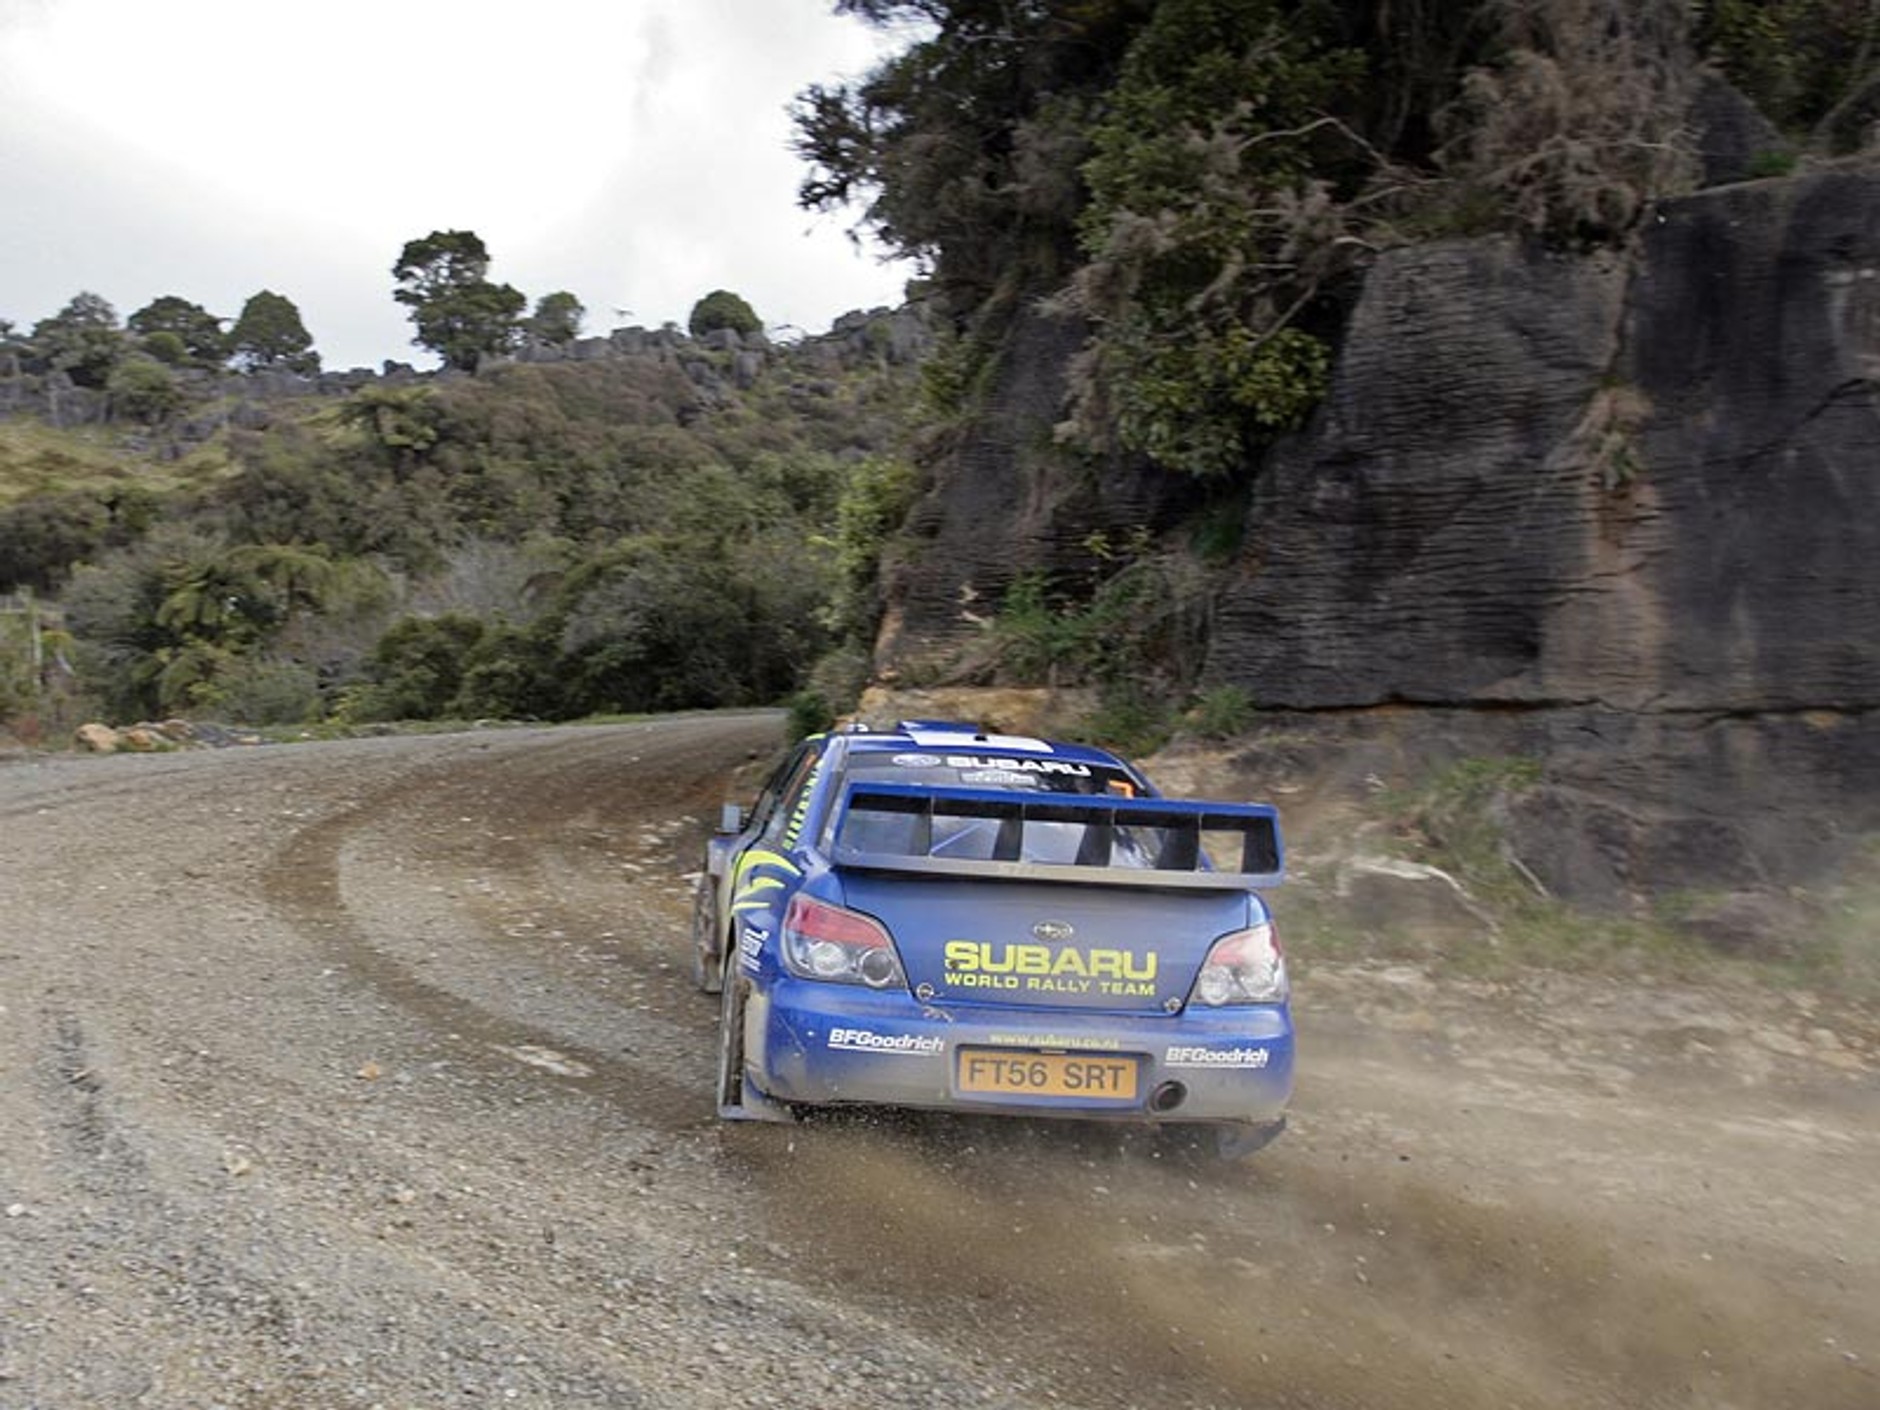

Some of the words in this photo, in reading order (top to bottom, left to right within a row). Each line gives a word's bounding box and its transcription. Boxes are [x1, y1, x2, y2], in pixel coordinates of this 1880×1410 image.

[946, 755, 1092, 777] SUBARU
[944, 940, 1158, 980] SUBARU
[944, 972, 1020, 989] WORLD
[1026, 977, 1090, 993] RALLY
[1100, 981, 1156, 996] TEAM
[829, 1027, 945, 1052] BFGoodrich
[1165, 1046, 1270, 1067] BFGoodrich
[968, 1057, 1048, 1087] FT56
[1063, 1062, 1126, 1091] SRT
